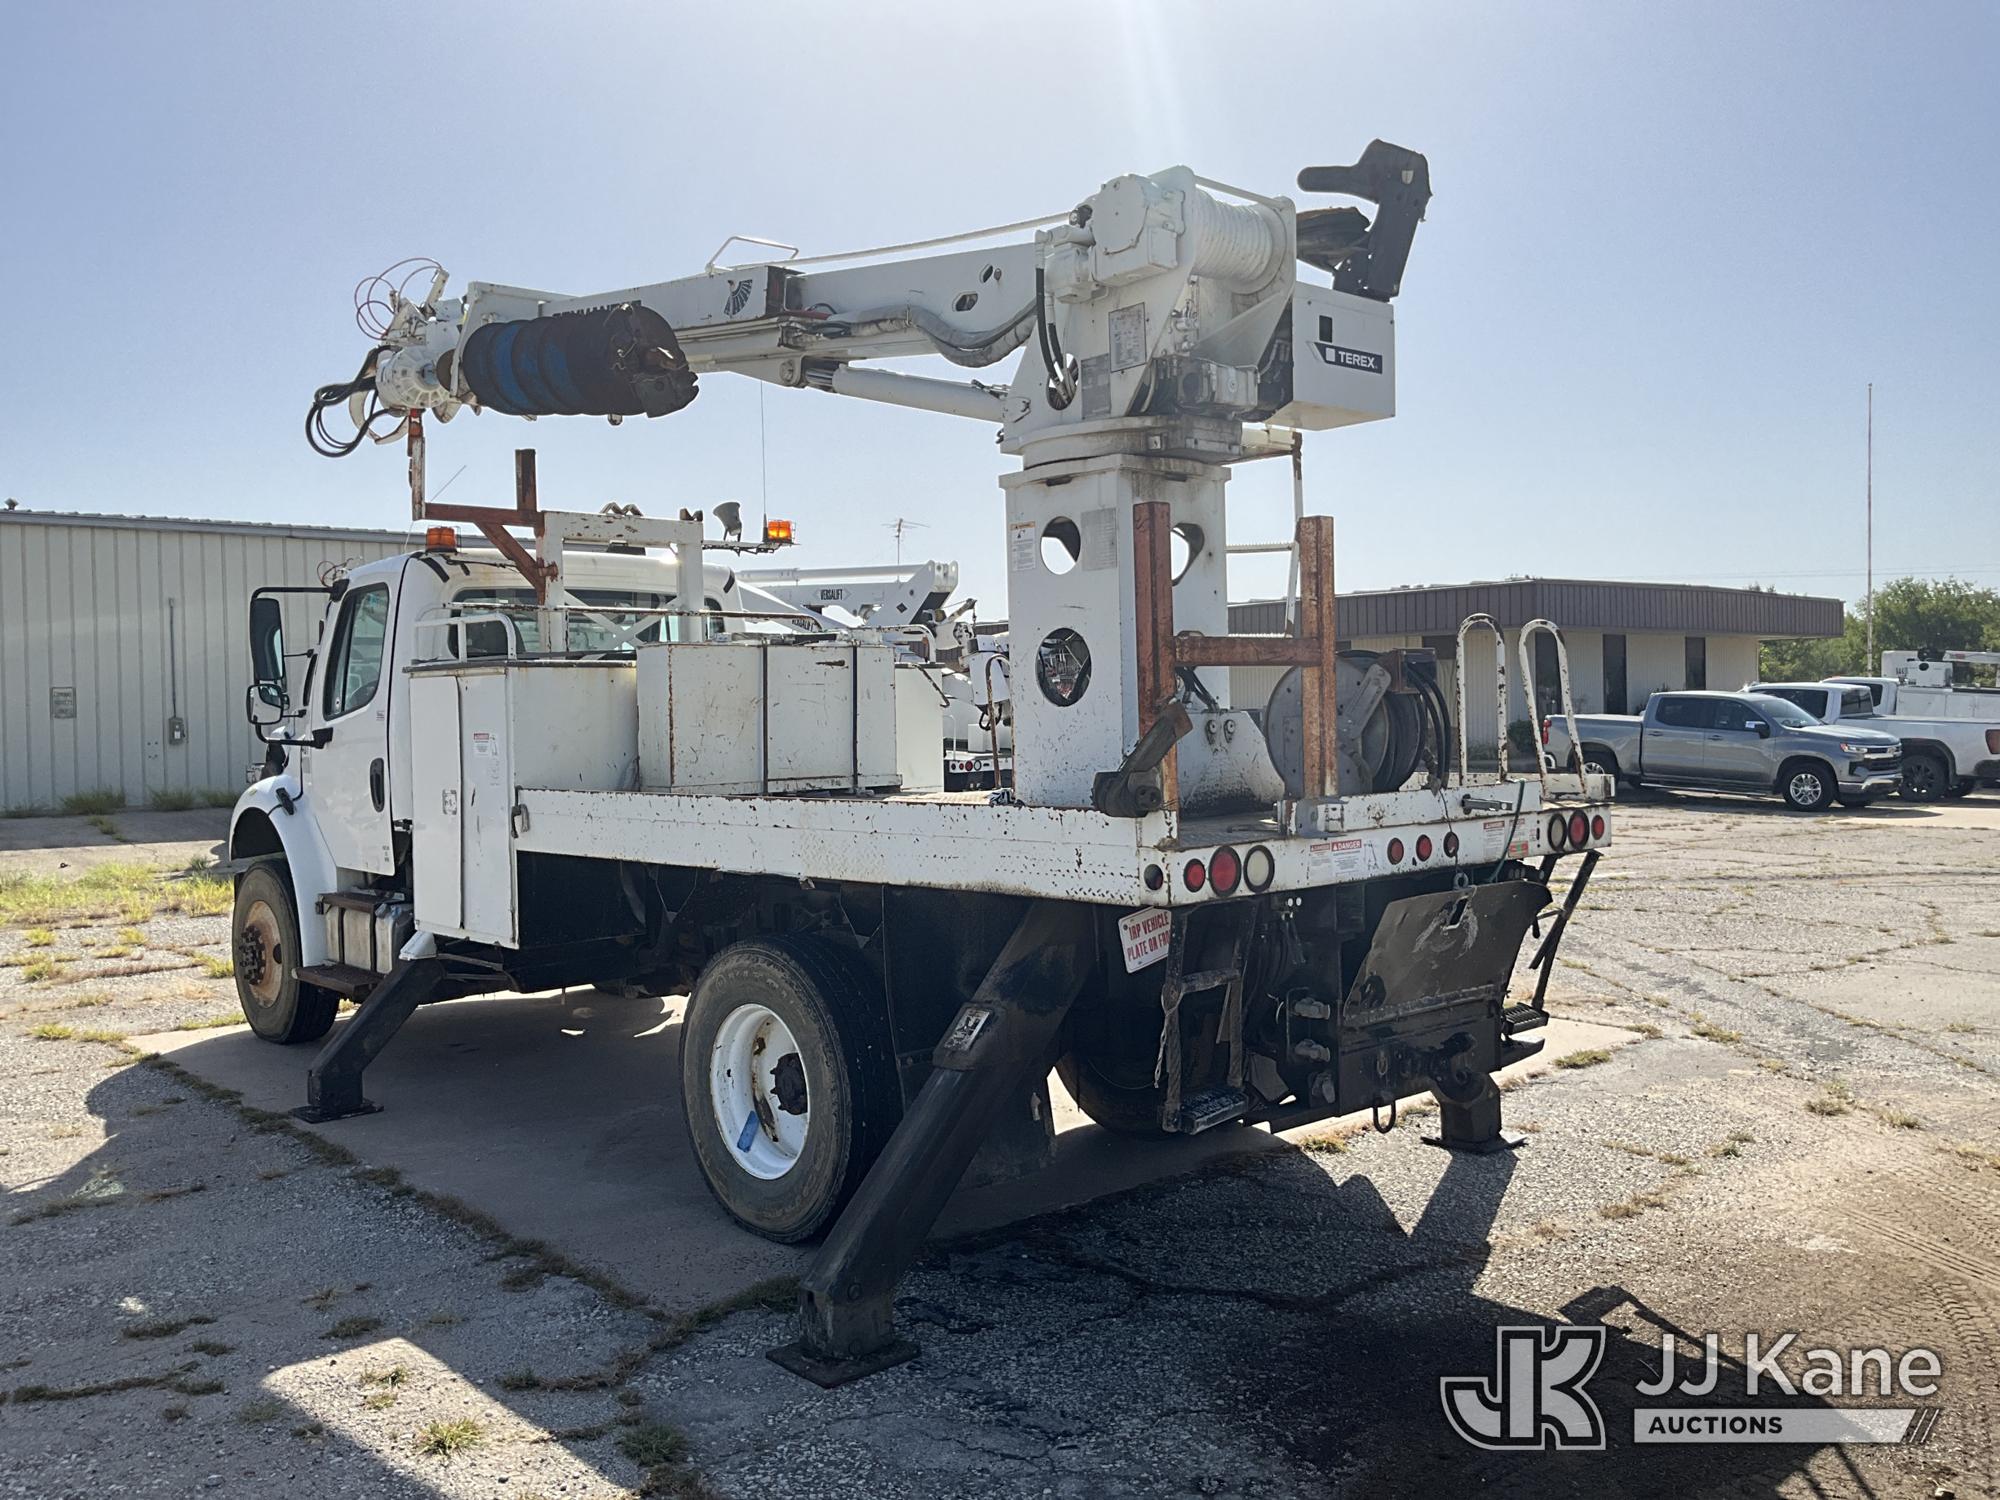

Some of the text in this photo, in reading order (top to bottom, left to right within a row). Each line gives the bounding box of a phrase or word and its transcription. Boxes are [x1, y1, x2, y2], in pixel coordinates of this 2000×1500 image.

[1338, 351, 1375, 369] TEREX
[820, 588, 843, 600] VERSALIFT
[1338, 840, 1361, 850] DANGER
[1141, 911, 1170, 935] VEHICLE
[1126, 930, 1171, 962] PLATE ON FRO
